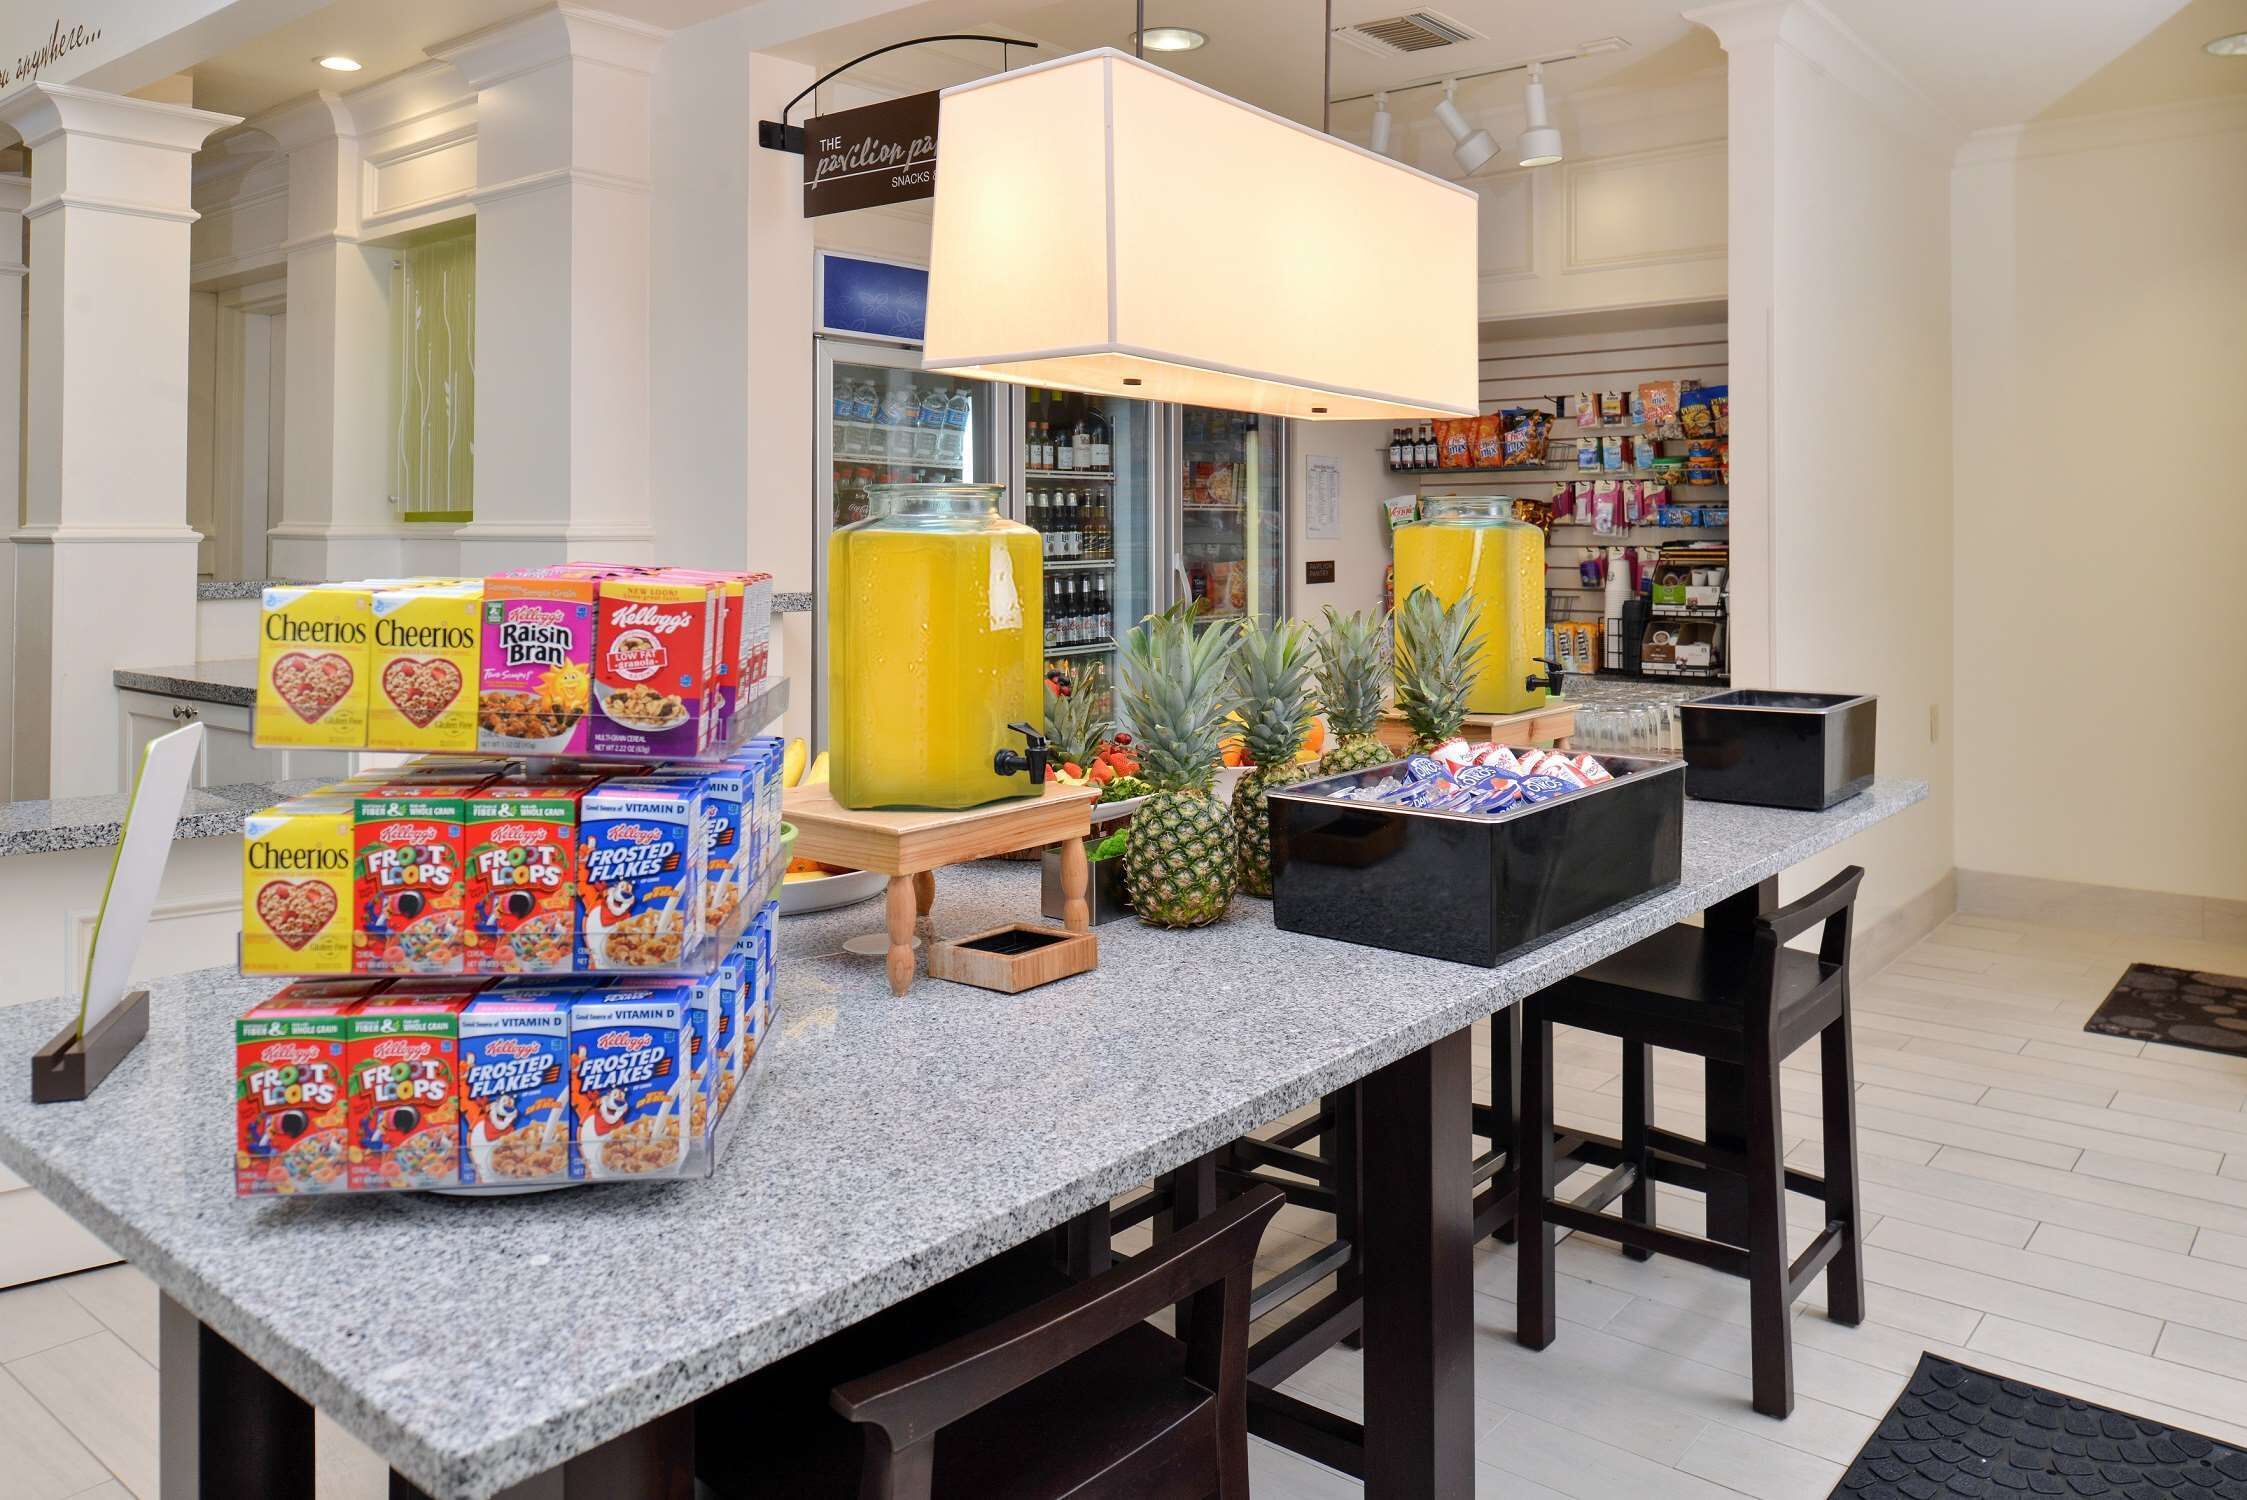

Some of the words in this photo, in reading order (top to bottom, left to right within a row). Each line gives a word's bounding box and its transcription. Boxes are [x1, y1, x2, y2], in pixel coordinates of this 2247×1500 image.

[820, 136, 842, 152] THE
[811, 136, 905, 190] pavilion
[891, 170, 930, 188] SNACKS
[266, 613, 366, 644] Cheerios
[611, 604, 694, 634] Kellogg's
[375, 618, 474, 649] Cheerios
[502, 623, 570, 648] Raisin
[510, 643, 562, 665] Bran
[615, 652, 640, 662] LOW
[641, 650, 657, 659] FAT
[732, 784, 739, 792] D
[387, 803, 403, 817] &
[498, 803, 515, 817] &
[625, 803, 673, 814] VITAMIN
[677, 804, 685, 814] D
[249, 841, 349, 870] Cheerios
[369, 845, 445, 874] FROOT
[479, 846, 554, 875] FROOT
[587, 841, 674, 868] FROSTED
[381, 865, 451, 886] LOOPS
[492, 866, 561, 887] LOOPS
[588, 858, 663, 882] FLAKES
[502, 1018, 550, 1027] VITAMIN
[554, 1017, 562, 1025] D
[615, 1010, 663, 1019] VITAMIN
[667, 1009, 675, 1018] D
[468, 1054, 554, 1083] FROSTED
[579, 1047, 665, 1077] FROSTED
[251, 1064, 328, 1093] FROOT
[362, 1061, 439, 1090] FROOT
[470, 1071, 544, 1098] FLAKES
[581, 1064, 654, 1092] FLAKES
[263, 1083, 336, 1106] LOOPS
[375, 1080, 445, 1101] LOOPS
